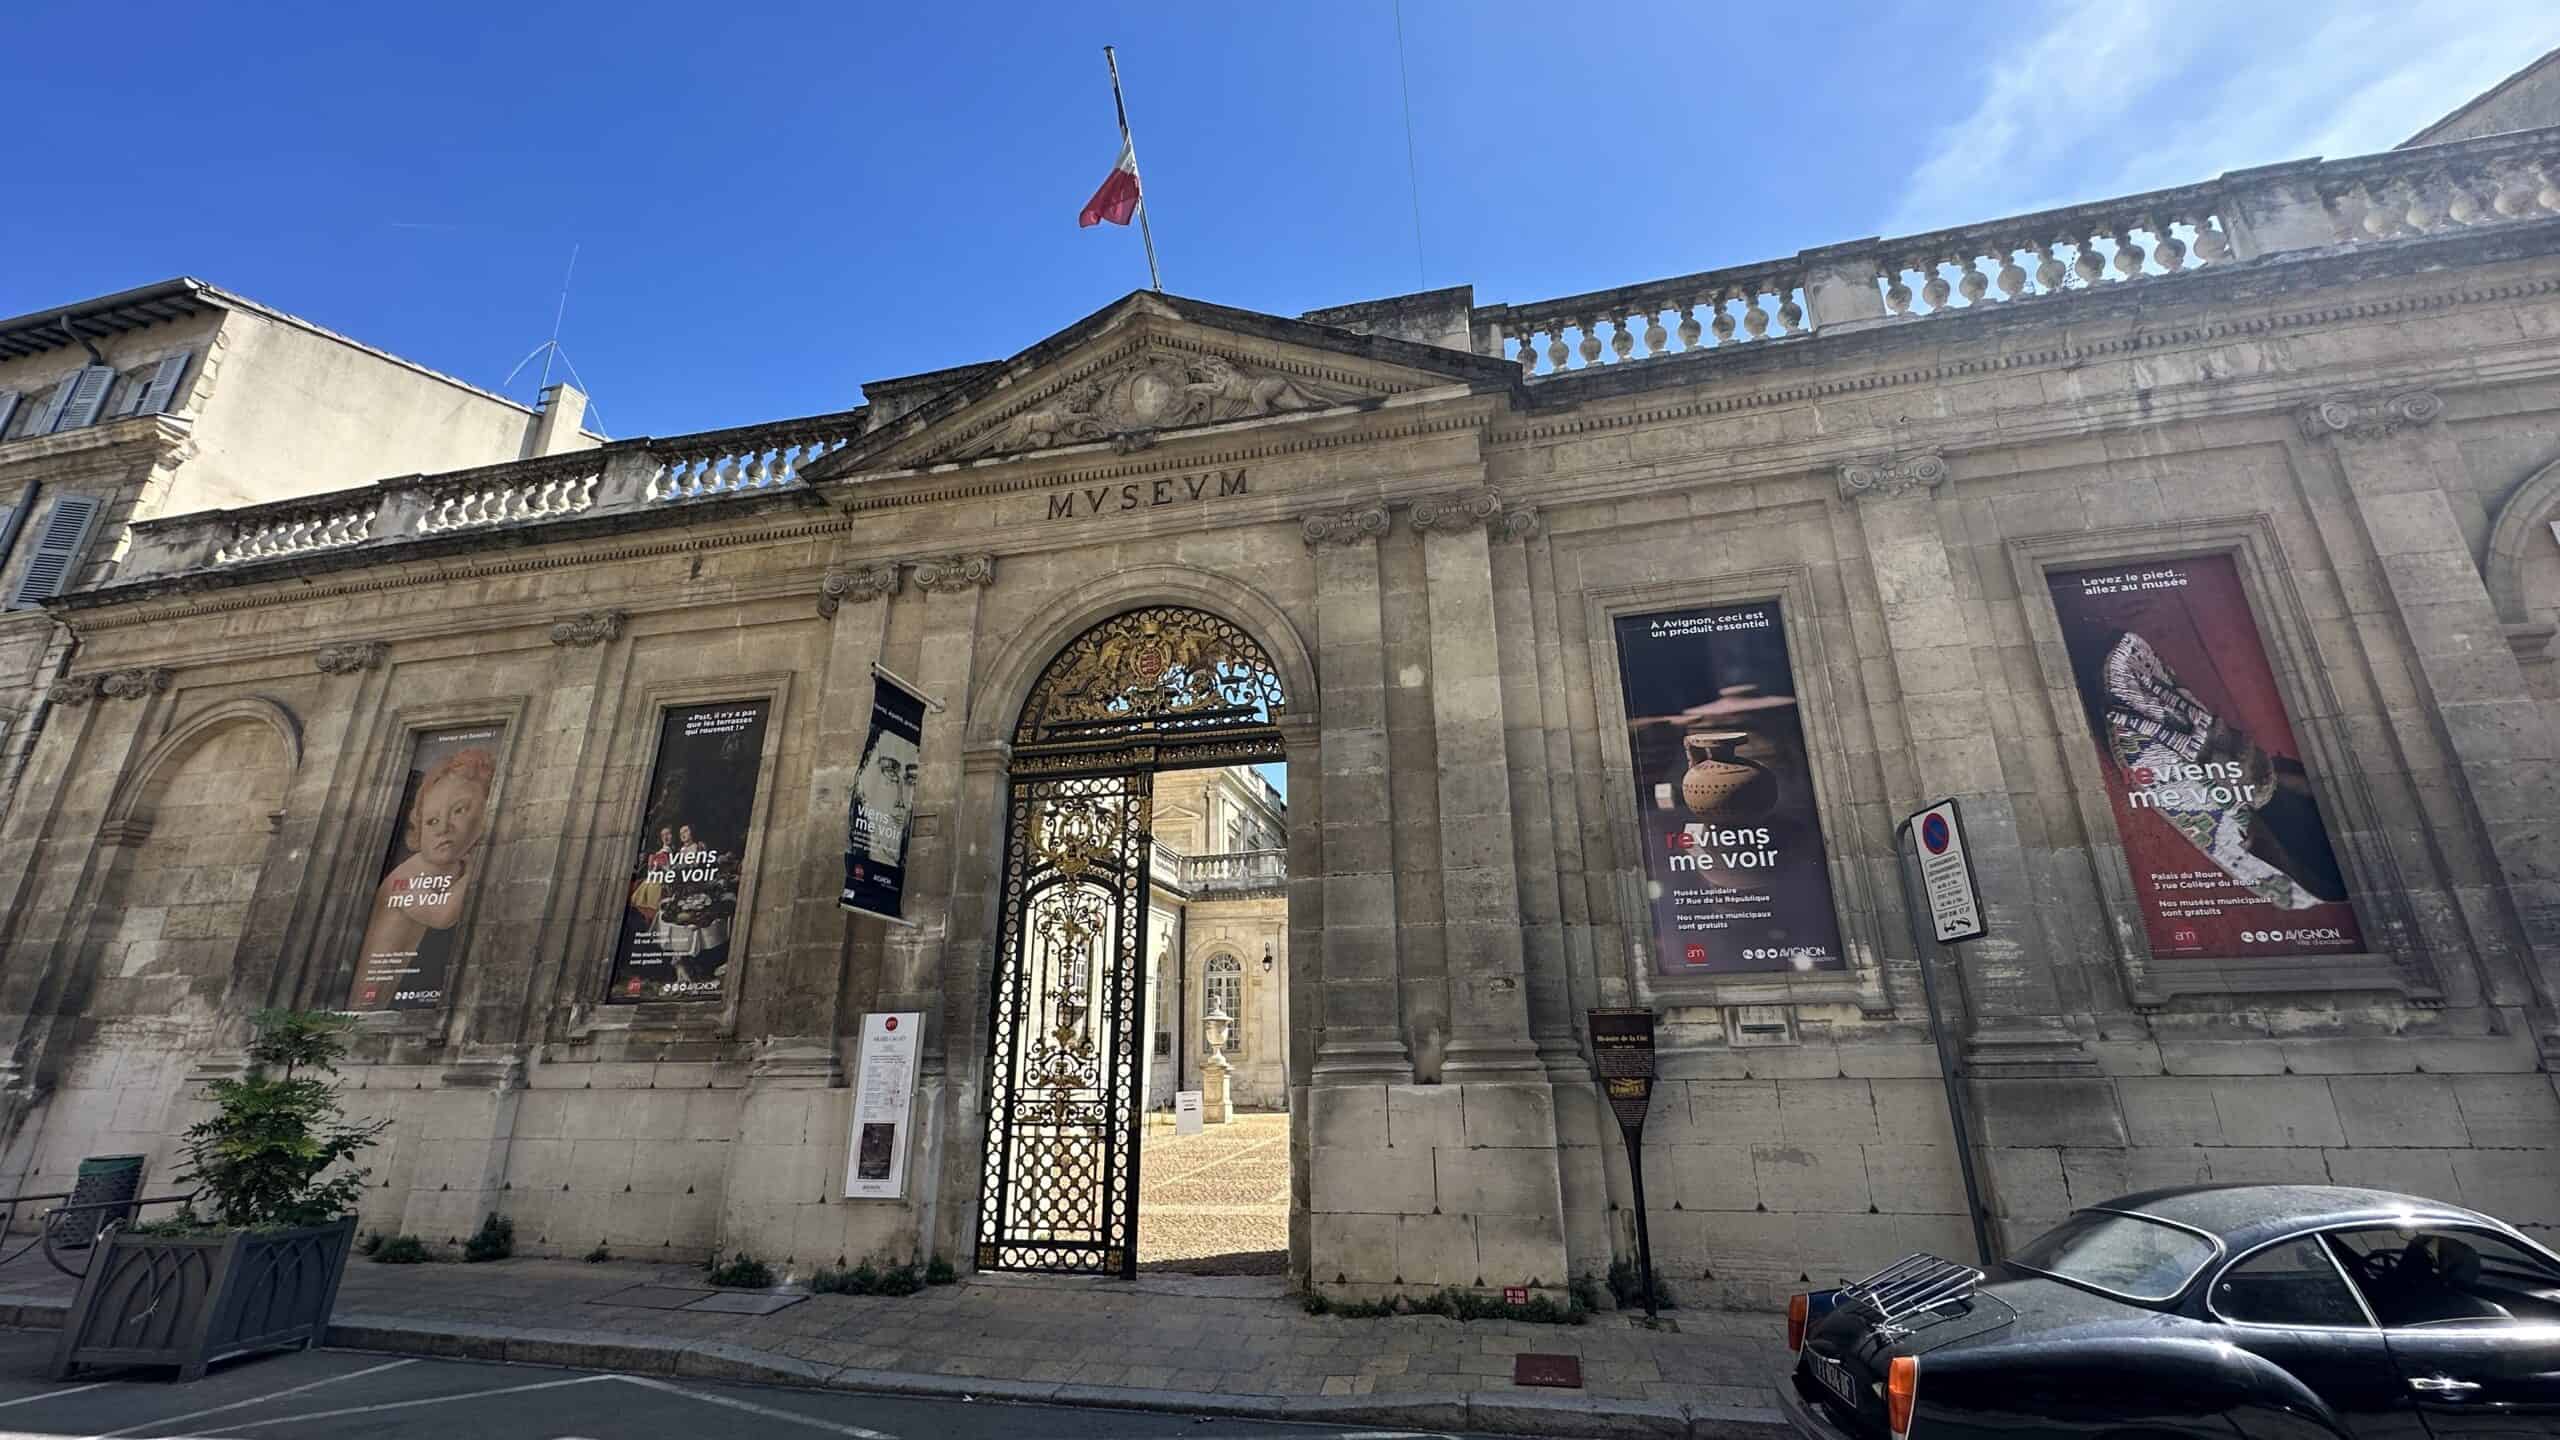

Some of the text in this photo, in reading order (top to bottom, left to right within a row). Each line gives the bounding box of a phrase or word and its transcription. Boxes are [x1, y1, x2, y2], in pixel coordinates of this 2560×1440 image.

[1047, 469, 1250, 521] MVSEVM
[2082, 575, 2122, 587] Levez
[2125, 573, 2138, 582] le
[2085, 578, 2188, 595] allez au musée
[1663, 617, 1715, 628] Avignon,
[1718, 612, 1742, 623] ceci
[1745, 610, 1765, 620] est
[1651, 618, 1769, 638] un produit essentiel
[741, 709, 757, 718] pas
[686, 717, 753, 729] que les terrasses
[685, 728, 698, 736] qui
[2121, 760, 2243, 786] reviens
[2128, 778, 2256, 809] me voir
[855, 817, 875, 833] me
[879, 824, 902, 841] voir
[1665, 823, 1771, 849] reviens
[1669, 843, 1779, 872] me voir
[646, 862, 719, 884] me voir
[2180, 871, 2193, 879] du
[387, 887, 452, 908] me voir
[1686, 897, 1702, 905] Rue
[1703, 896, 1714, 904] de
[1714, 896, 1724, 904] la
[2159, 896, 2272, 908] Nos musées municipaux
[1693, 913, 1724, 921] musées
[1724, 911, 1772, 920] municipaux
[2161, 908, 2222, 917] sont gratuits
[1696, 921, 1728, 931] gratuits
[2285, 928, 2340, 941] AVIGNON
